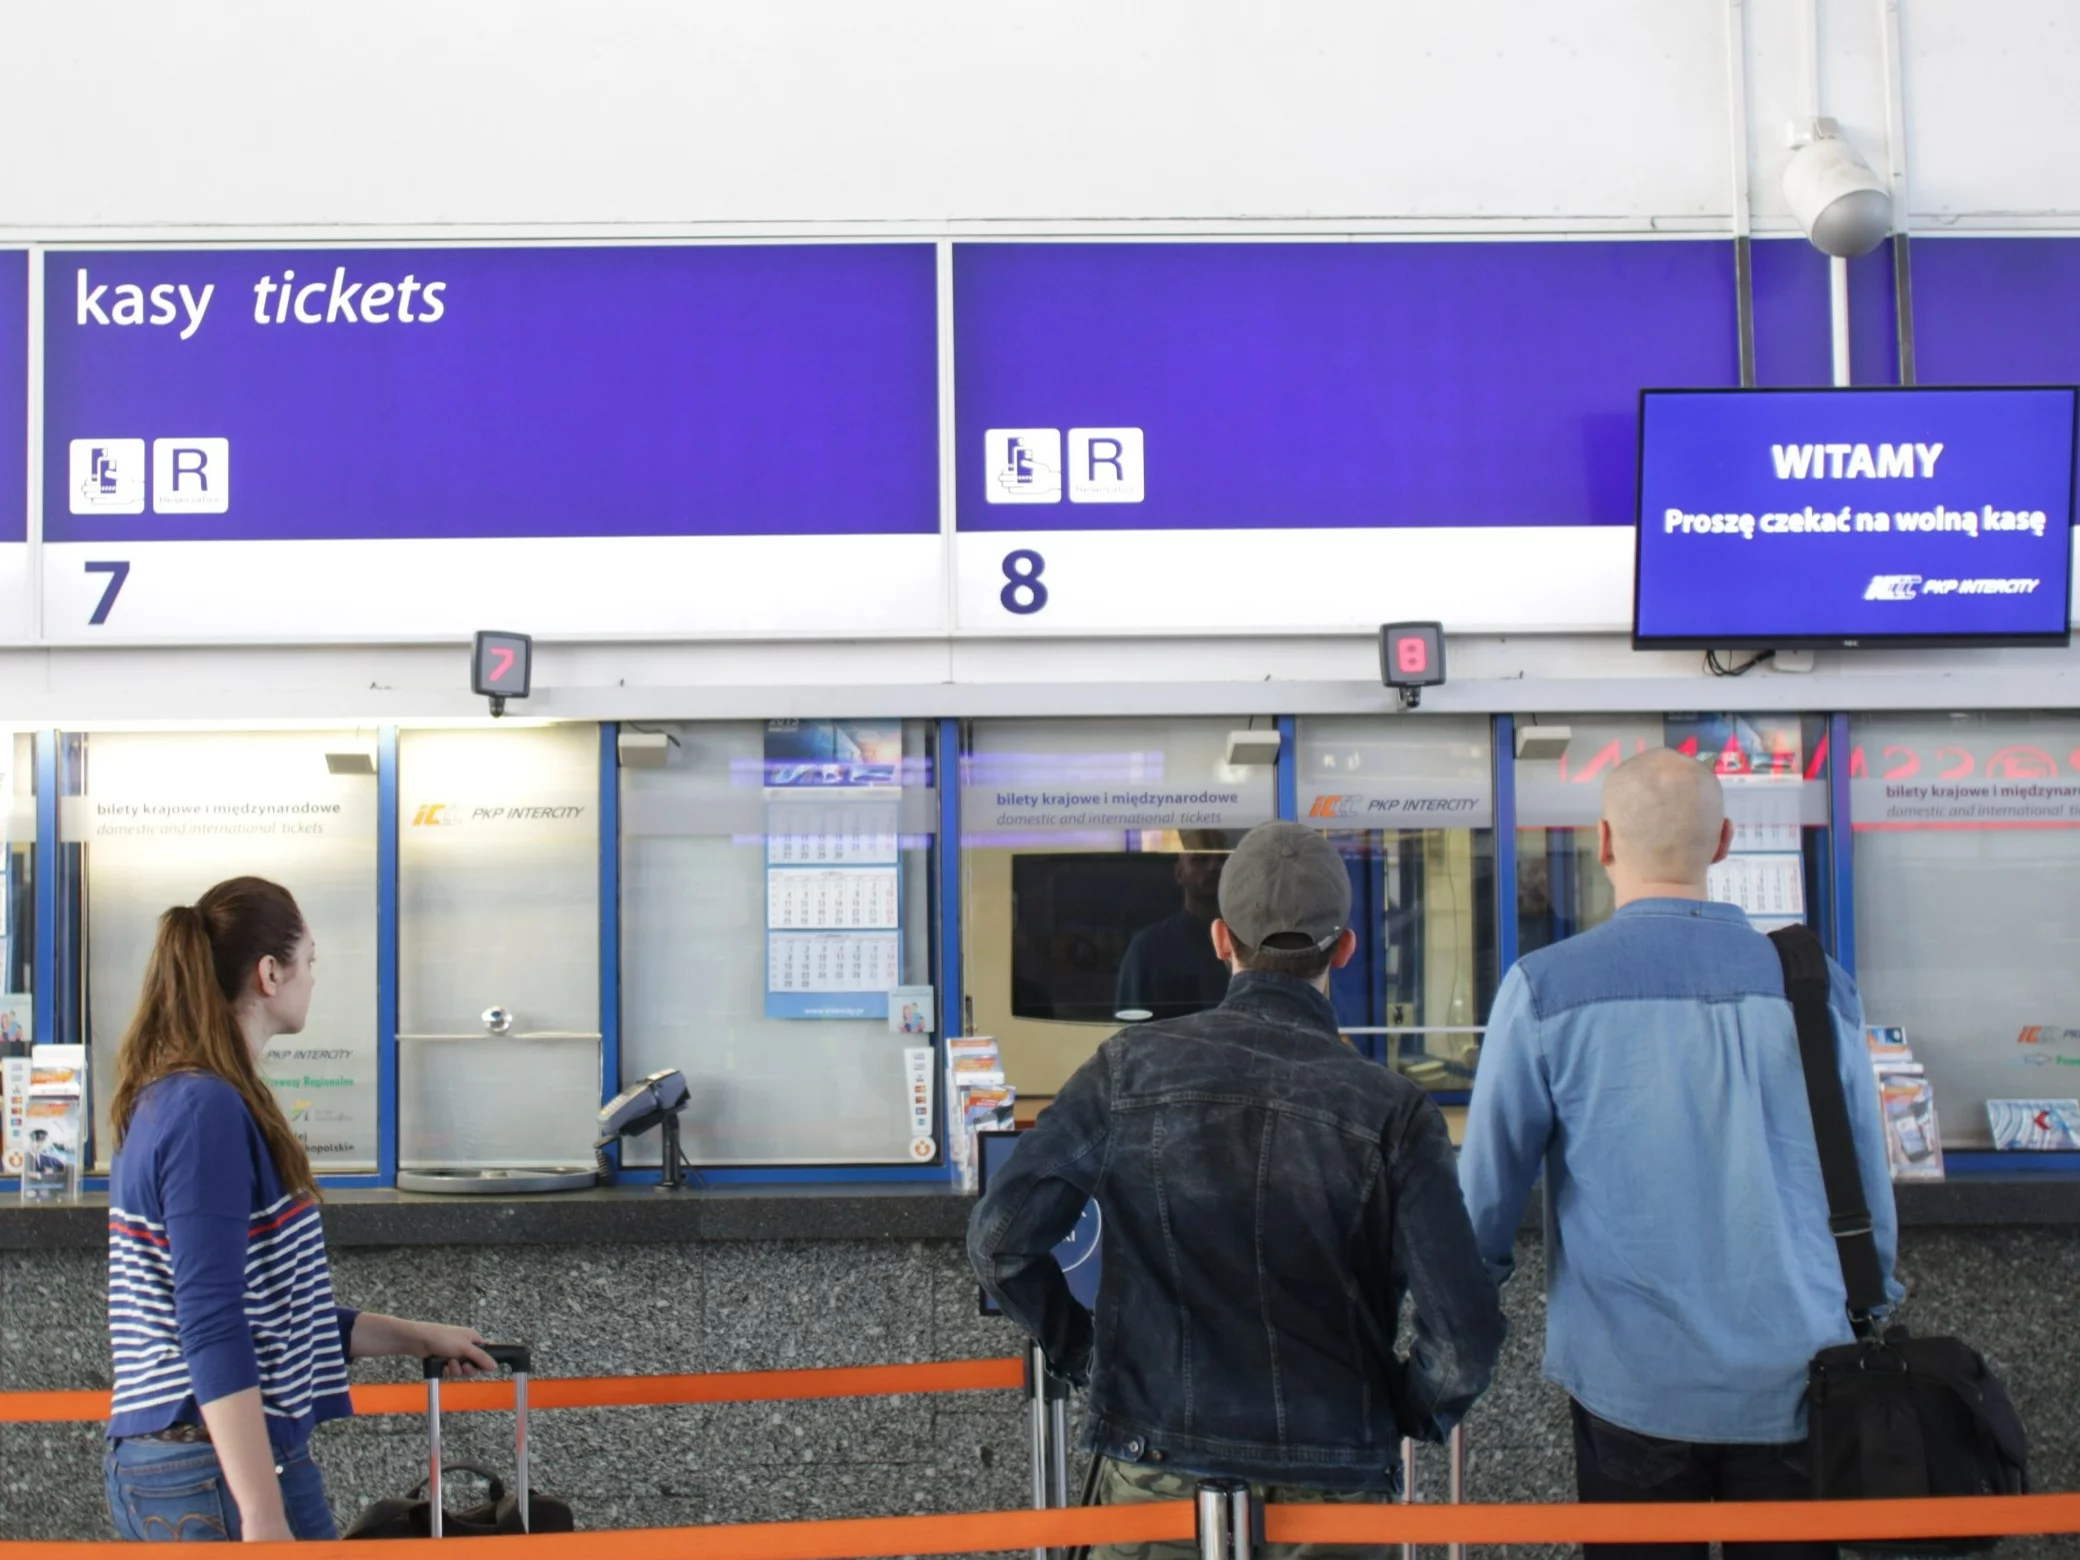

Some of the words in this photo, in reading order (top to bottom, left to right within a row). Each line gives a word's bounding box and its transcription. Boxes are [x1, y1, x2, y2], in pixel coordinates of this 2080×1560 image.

[77, 269, 214, 340] kasy
[253, 267, 447, 324] tickets
[1088, 437, 1124, 481] R
[1772, 443, 1944, 480] WITAMY
[172, 448, 209, 492] R
[1664, 508, 1755, 540] Proszę
[1760, 506, 1851, 534] czekać
[1856, 512, 1890, 533] na
[1896, 505, 1979, 537] wolną
[1983, 504, 2046, 537] kasę
[1000, 549, 1049, 616] 8
[1922, 579, 1959, 594] PKP
[1957, 578, 2040, 595] INTERCITY
[84, 560, 131, 626] 7
[1398, 637, 1427, 672] 8
[488, 649, 515, 682] 7
[996, 792, 1039, 807] bilety
[1042, 792, 1101, 808] krajowe
[1104, 793, 1108, 805] i
[1111, 791, 1238, 807] międzynarodowe
[1886, 784, 1928, 800] bilety
[1931, 784, 1990, 801] krajowe
[1993, 784, 1997, 797] i
[96, 802, 139, 817] bilety
[143, 802, 202, 817] krajowe
[205, 803, 209, 815] i
[213, 801, 342, 817] międzynarodowe
[471, 806, 505, 820] PKP
[506, 805, 586, 820] INTERCITY
[1367, 799, 1400, 812] PKP
[1402, 798, 1480, 812] INTERCITY
[1886, 803, 1944, 818] domestic
[1948, 804, 1975, 817] and
[1978, 803, 2064, 818] international
[996, 812, 1056, 826] domestic
[1059, 812, 1085, 825] and
[1088, 811, 1175, 825] international
[1180, 811, 1222, 825] tickets
[96, 821, 155, 836] domestic
[159, 822, 186, 836] and
[189, 821, 276, 836] international
[281, 821, 324, 835] tickets
[266, 1049, 292, 1060] PKP
[293, 1049, 354, 1060] INTERCITY
